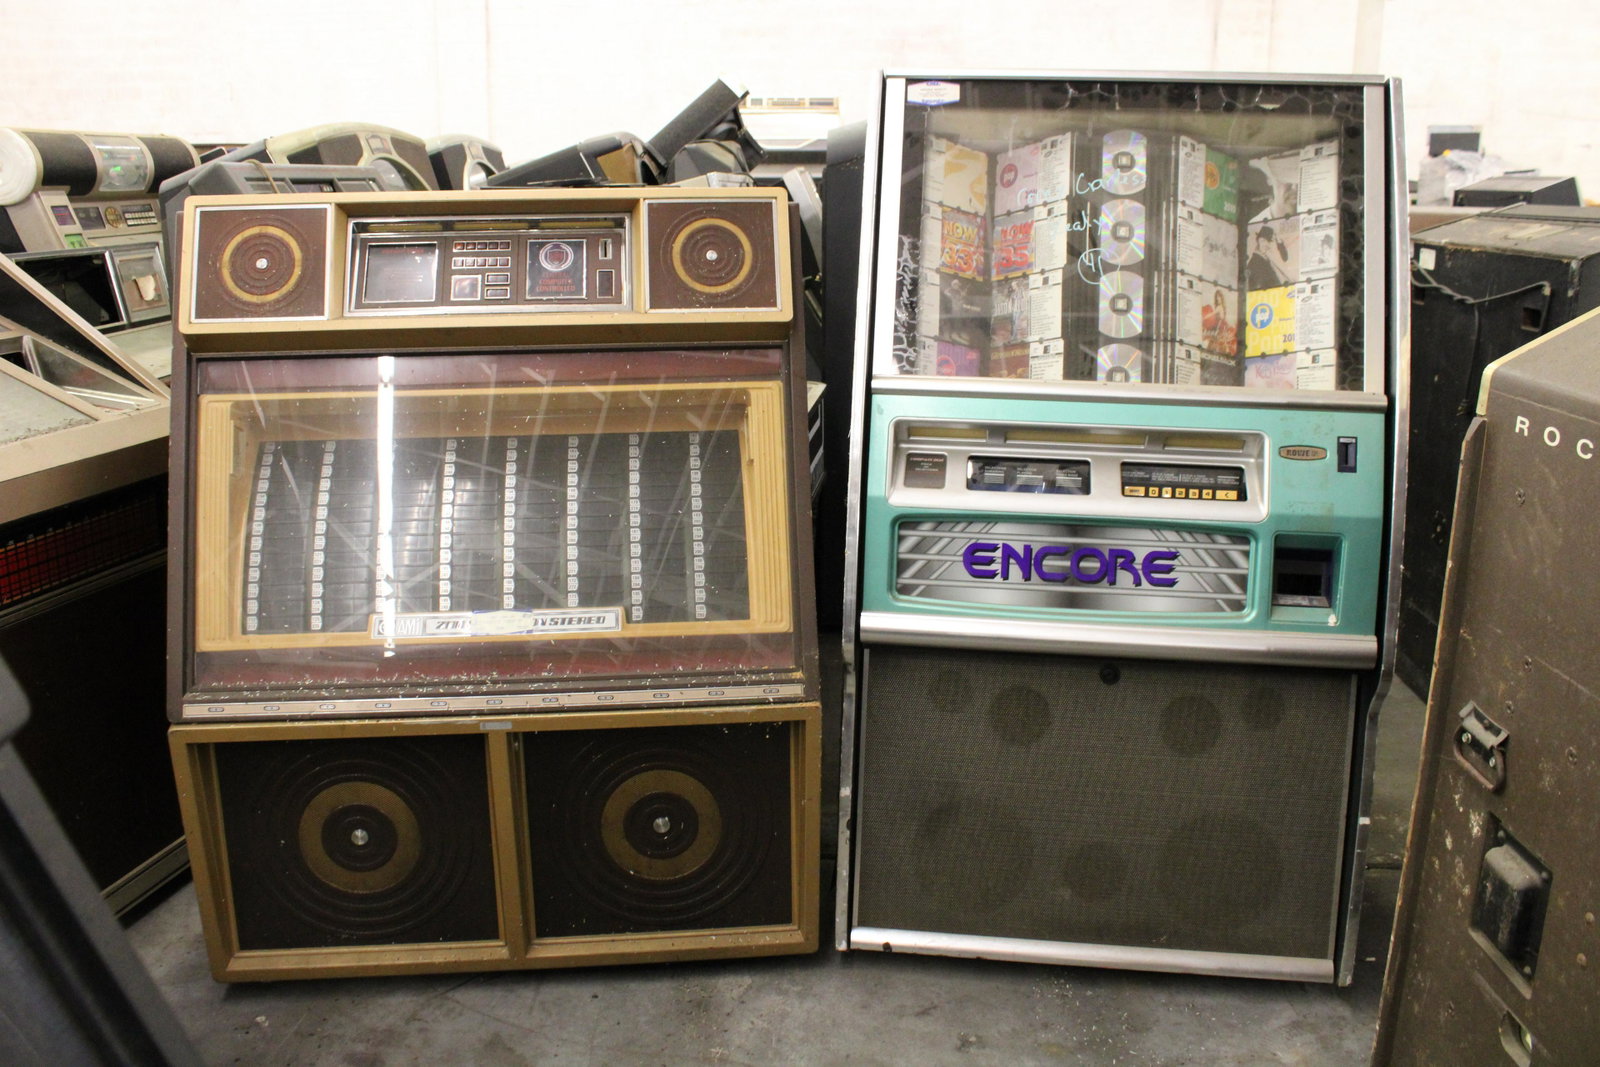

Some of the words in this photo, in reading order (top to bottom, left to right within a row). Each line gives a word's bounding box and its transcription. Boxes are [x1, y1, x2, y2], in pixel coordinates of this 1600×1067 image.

[943, 220, 978, 242] NOW
[1000, 219, 1035, 240] NOW
[1000, 245, 1029, 268] 35
[1286, 449, 1310, 457] ROWE
[963, 542, 1180, 587] ENCORE
[549, 616, 606, 626] STEREO
